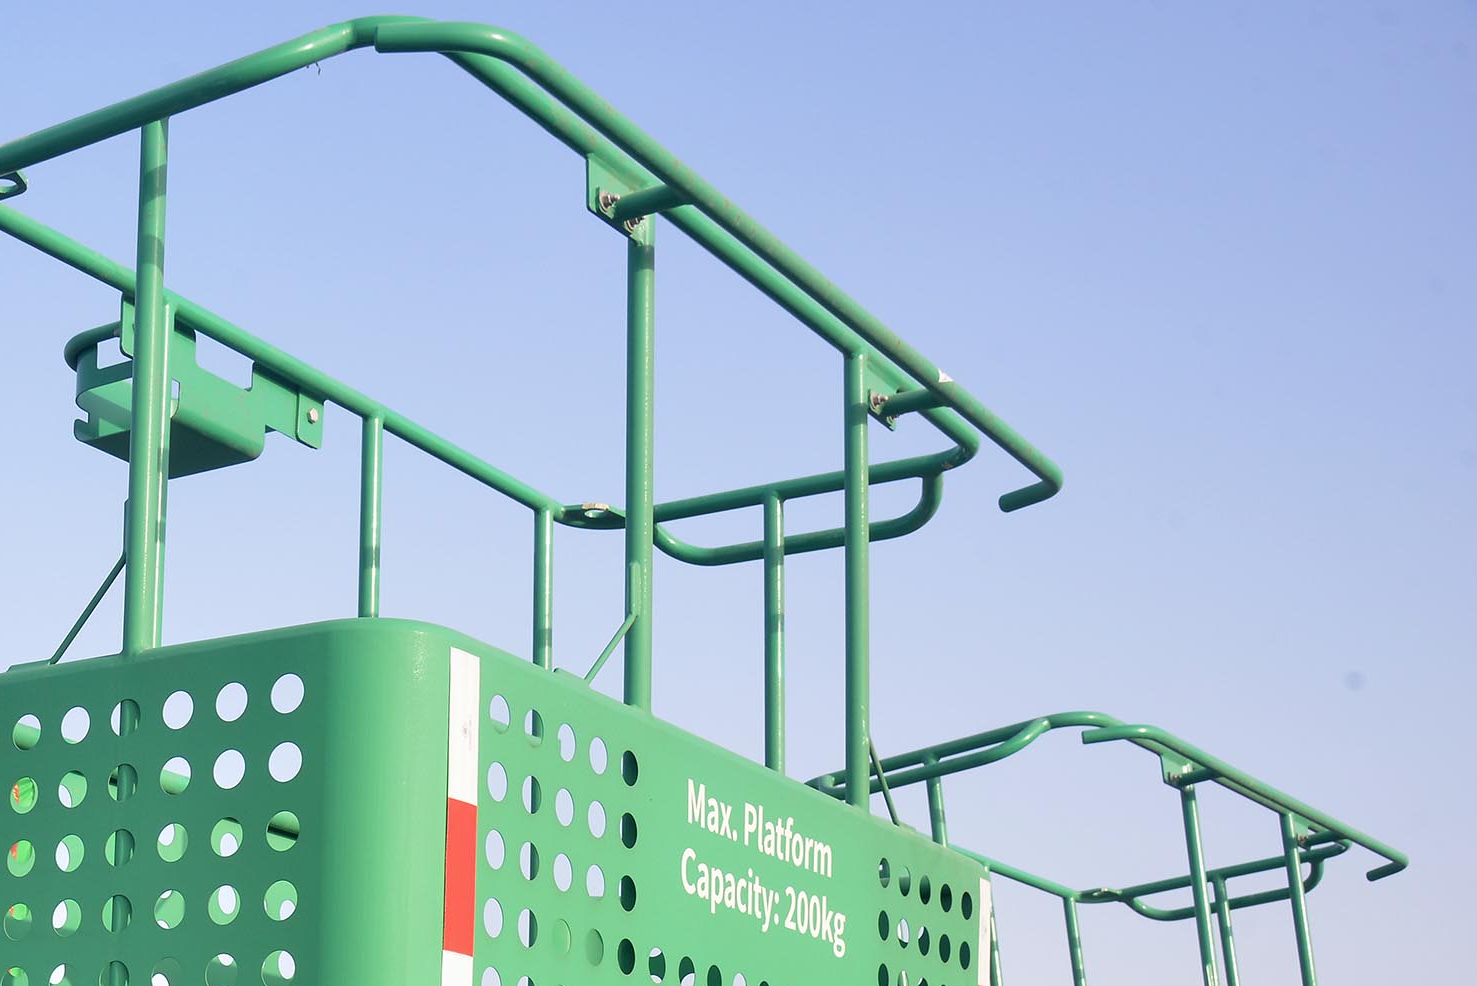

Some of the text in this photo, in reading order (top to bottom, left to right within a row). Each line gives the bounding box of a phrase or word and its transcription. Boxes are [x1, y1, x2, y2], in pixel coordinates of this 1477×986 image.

[687, 777, 833, 879] Max. Platform
[680, 847, 846, 958] Capacity: 200kg
